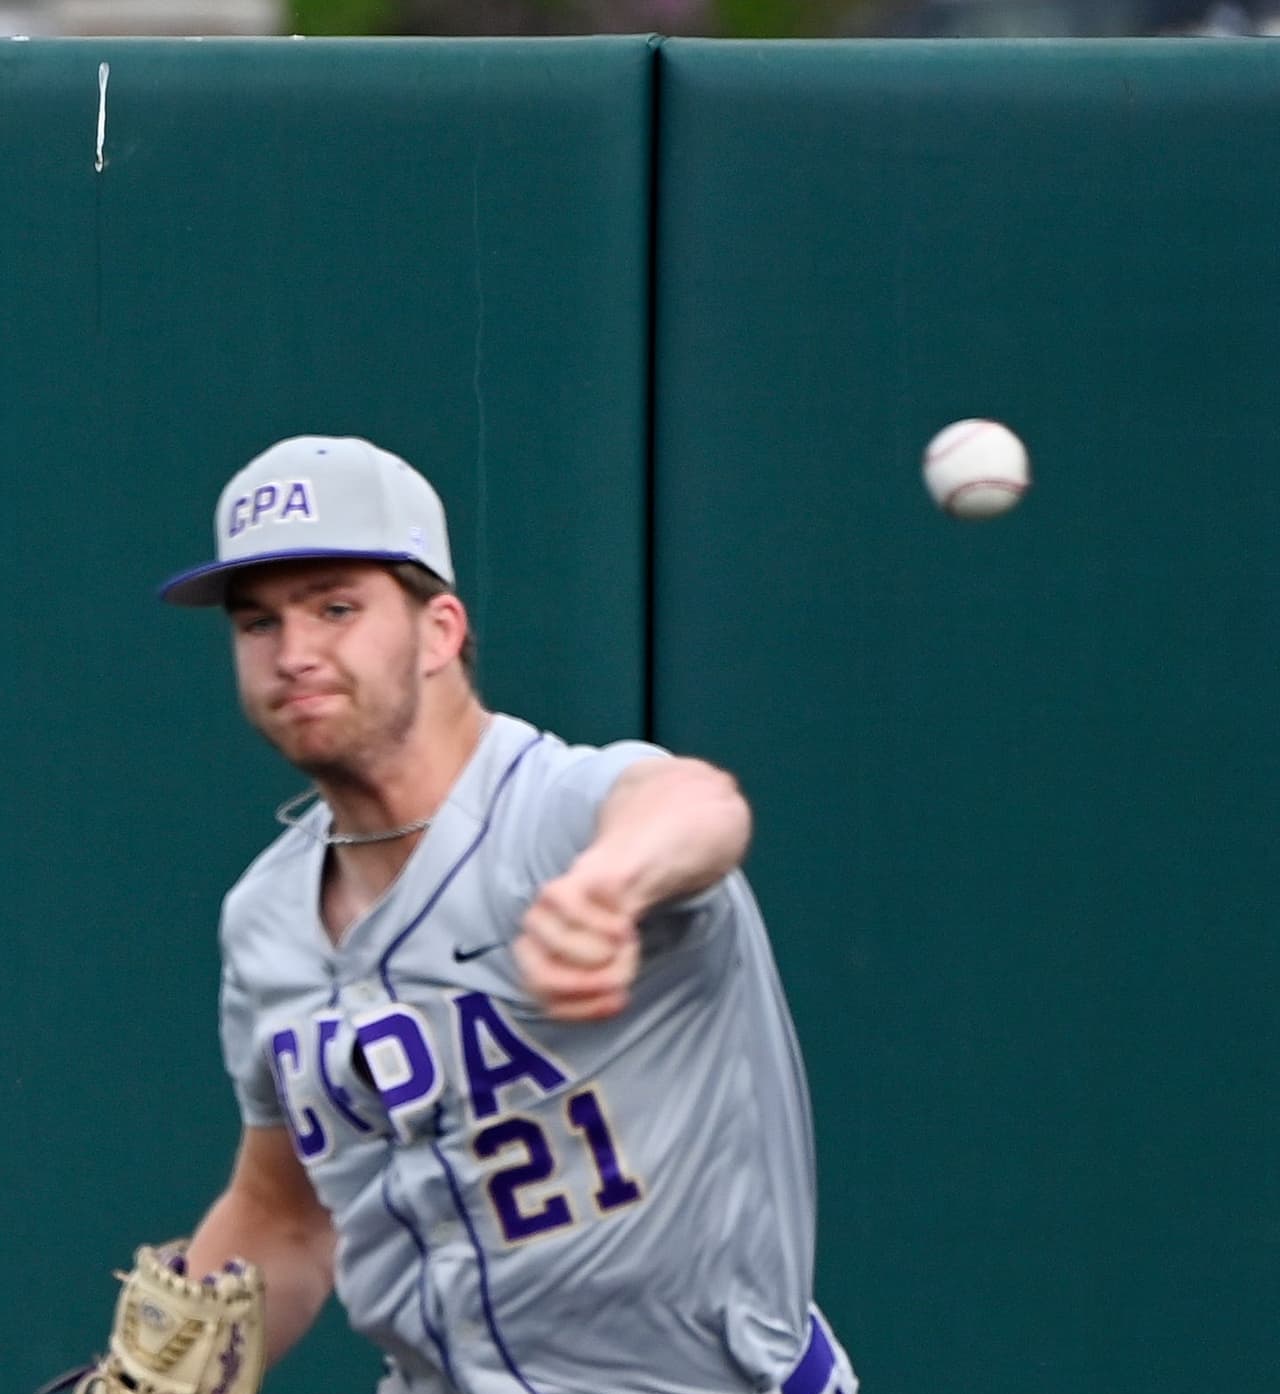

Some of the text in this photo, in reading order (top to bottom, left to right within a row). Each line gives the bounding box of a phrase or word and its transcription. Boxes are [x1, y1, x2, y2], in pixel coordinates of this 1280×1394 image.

[227, 479, 313, 538] CPA
[270, 990, 568, 1160] CPA
[471, 1088, 642, 1244] 21
